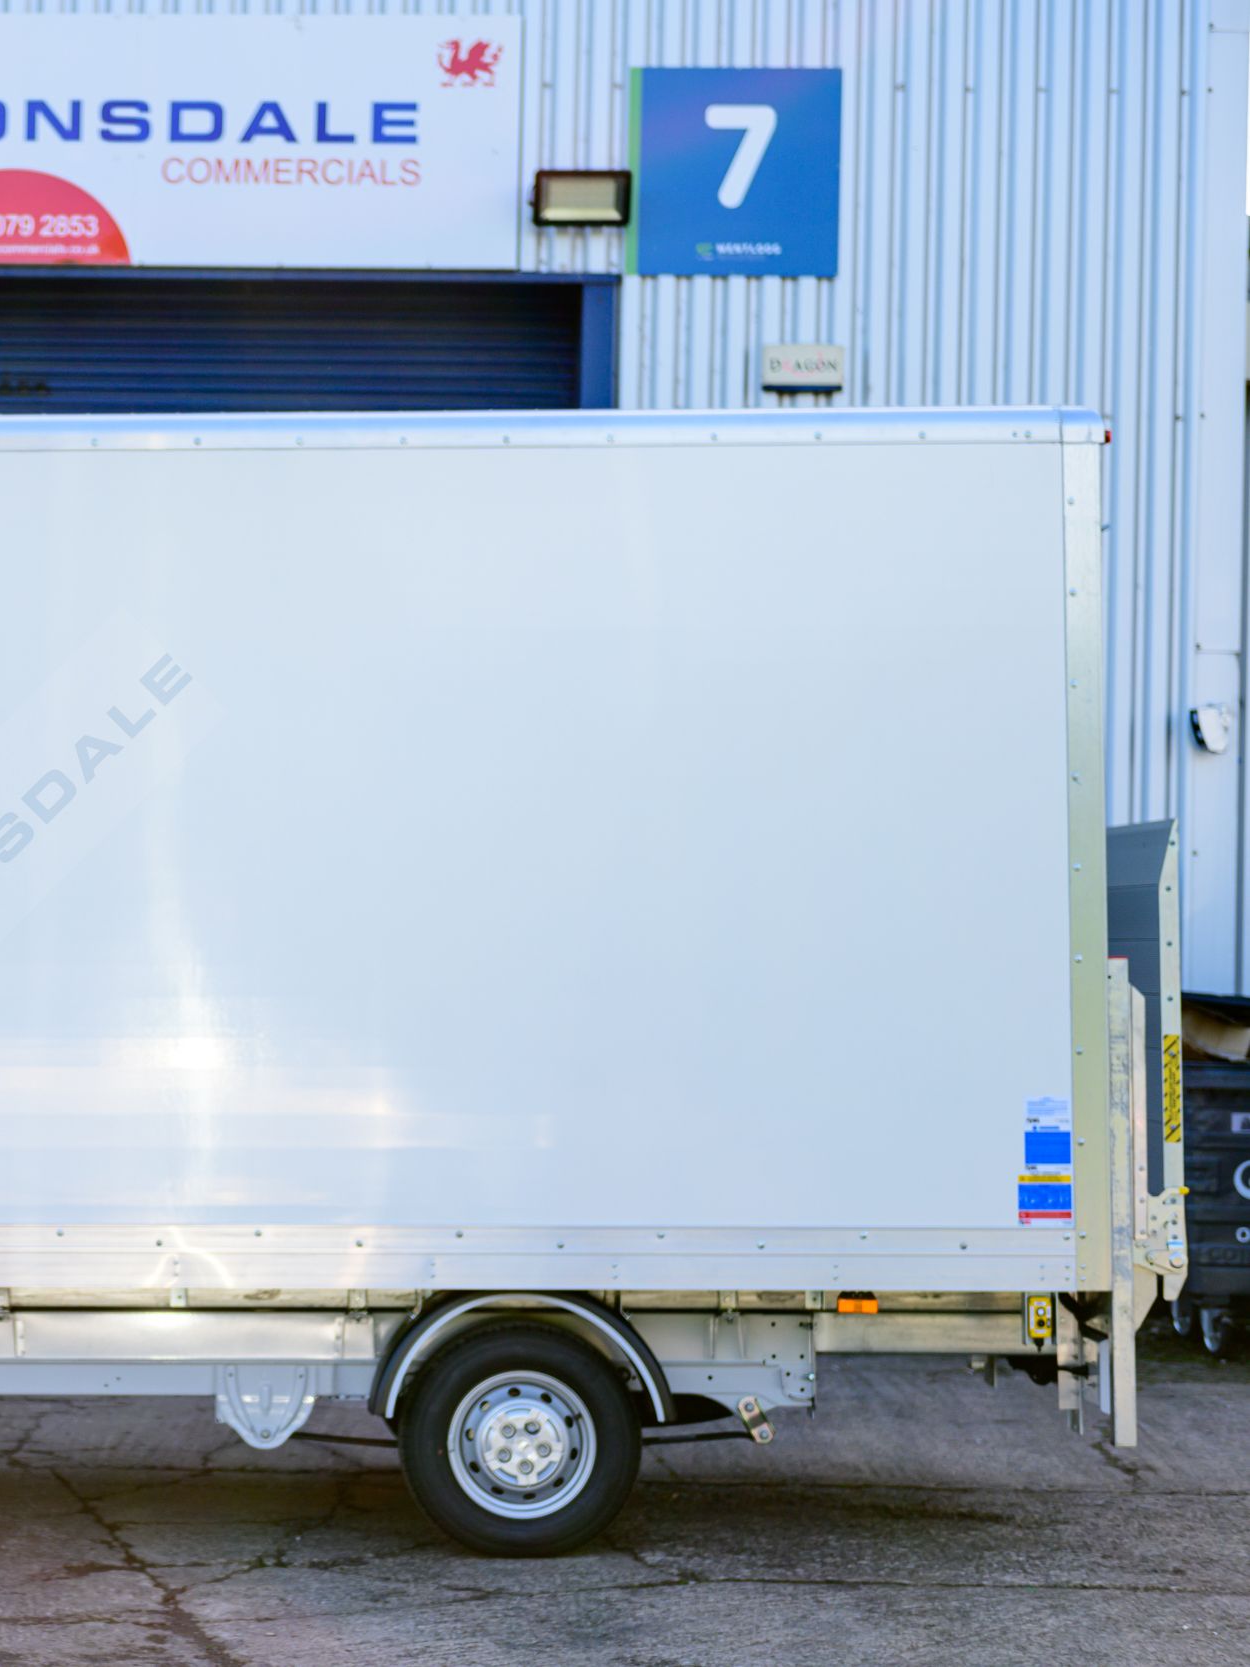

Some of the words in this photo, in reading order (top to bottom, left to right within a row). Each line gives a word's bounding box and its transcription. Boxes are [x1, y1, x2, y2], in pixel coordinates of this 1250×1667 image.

[704, 104, 777, 209] 7
[161, 157, 421, 188] COMMERCIALS
[39, 214, 100, 238] 2853
